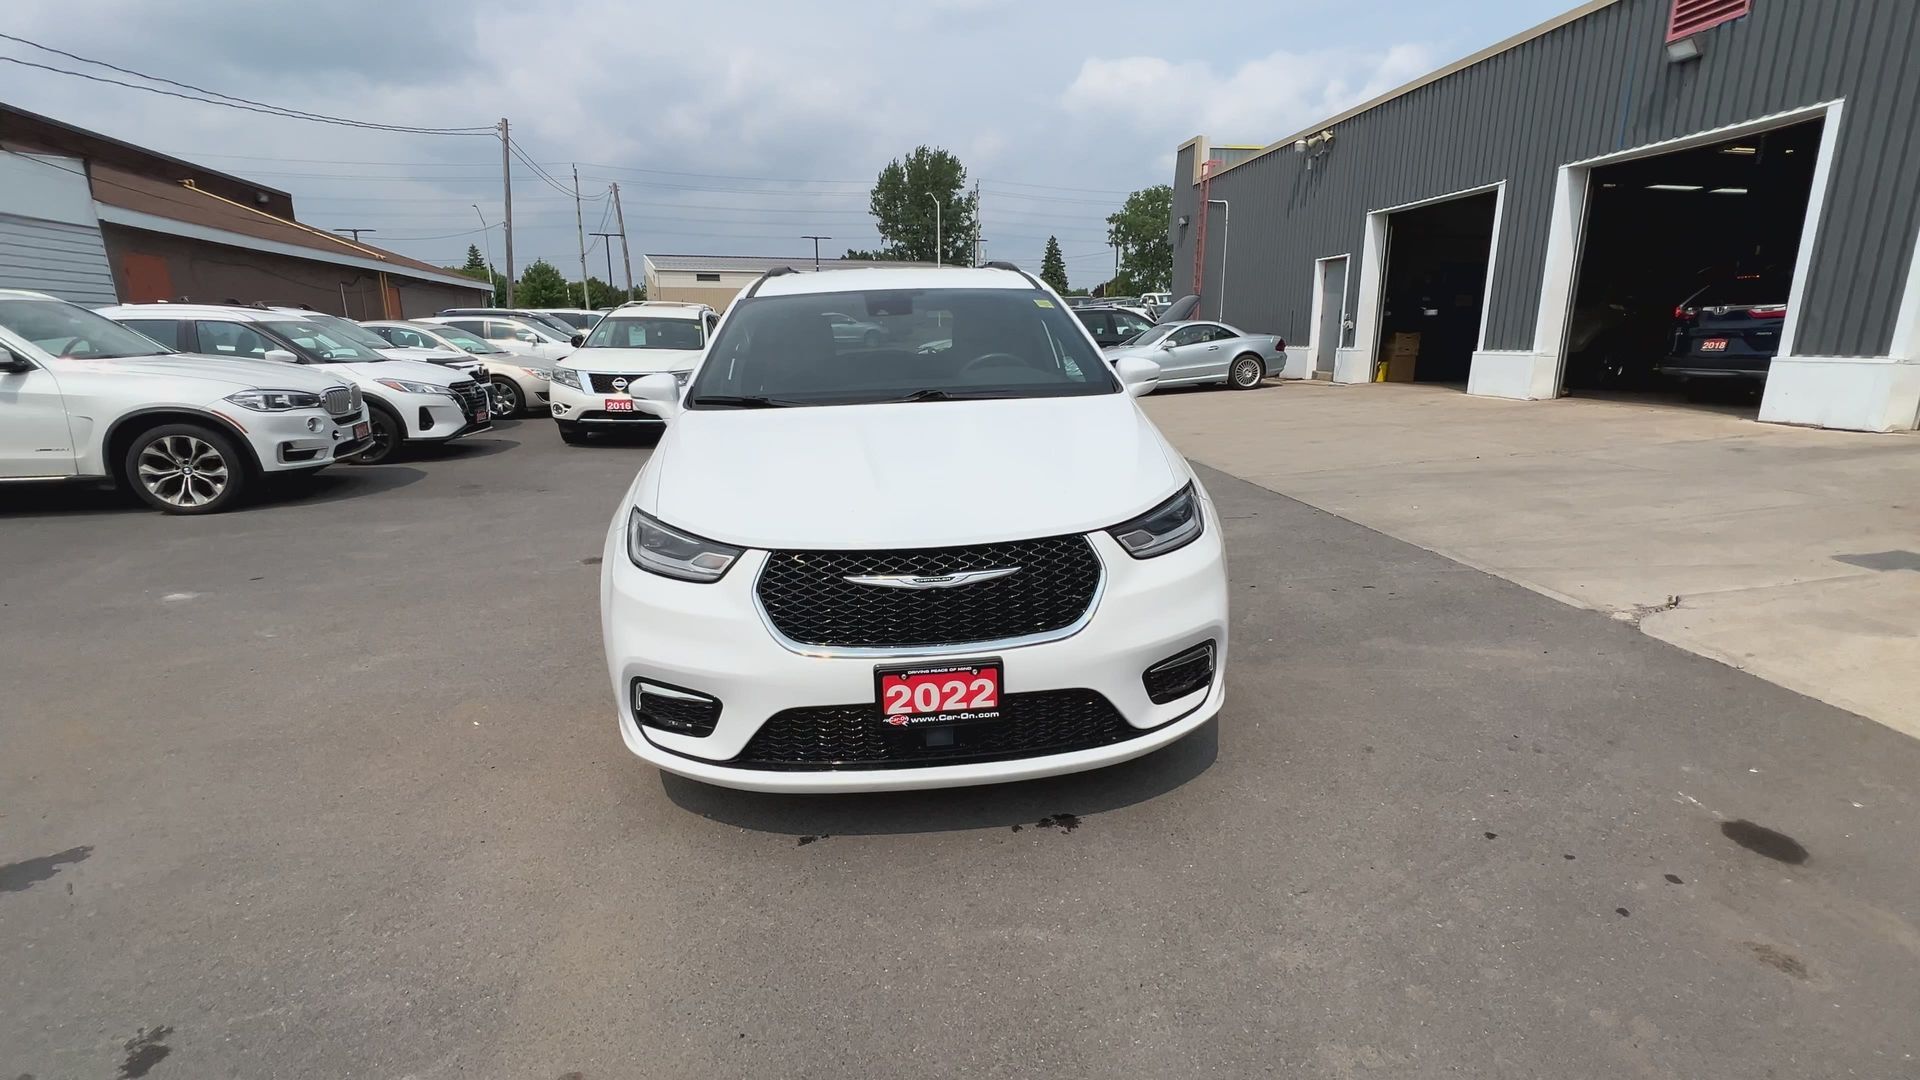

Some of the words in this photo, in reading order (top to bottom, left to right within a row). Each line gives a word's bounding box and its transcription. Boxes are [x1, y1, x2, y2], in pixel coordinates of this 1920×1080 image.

[1702, 341, 1726, 349] 2018
[607, 402, 631, 410] 2016
[886, 678, 995, 714] 2022
[910, 711, 1000, 723] www.Car-On.com
